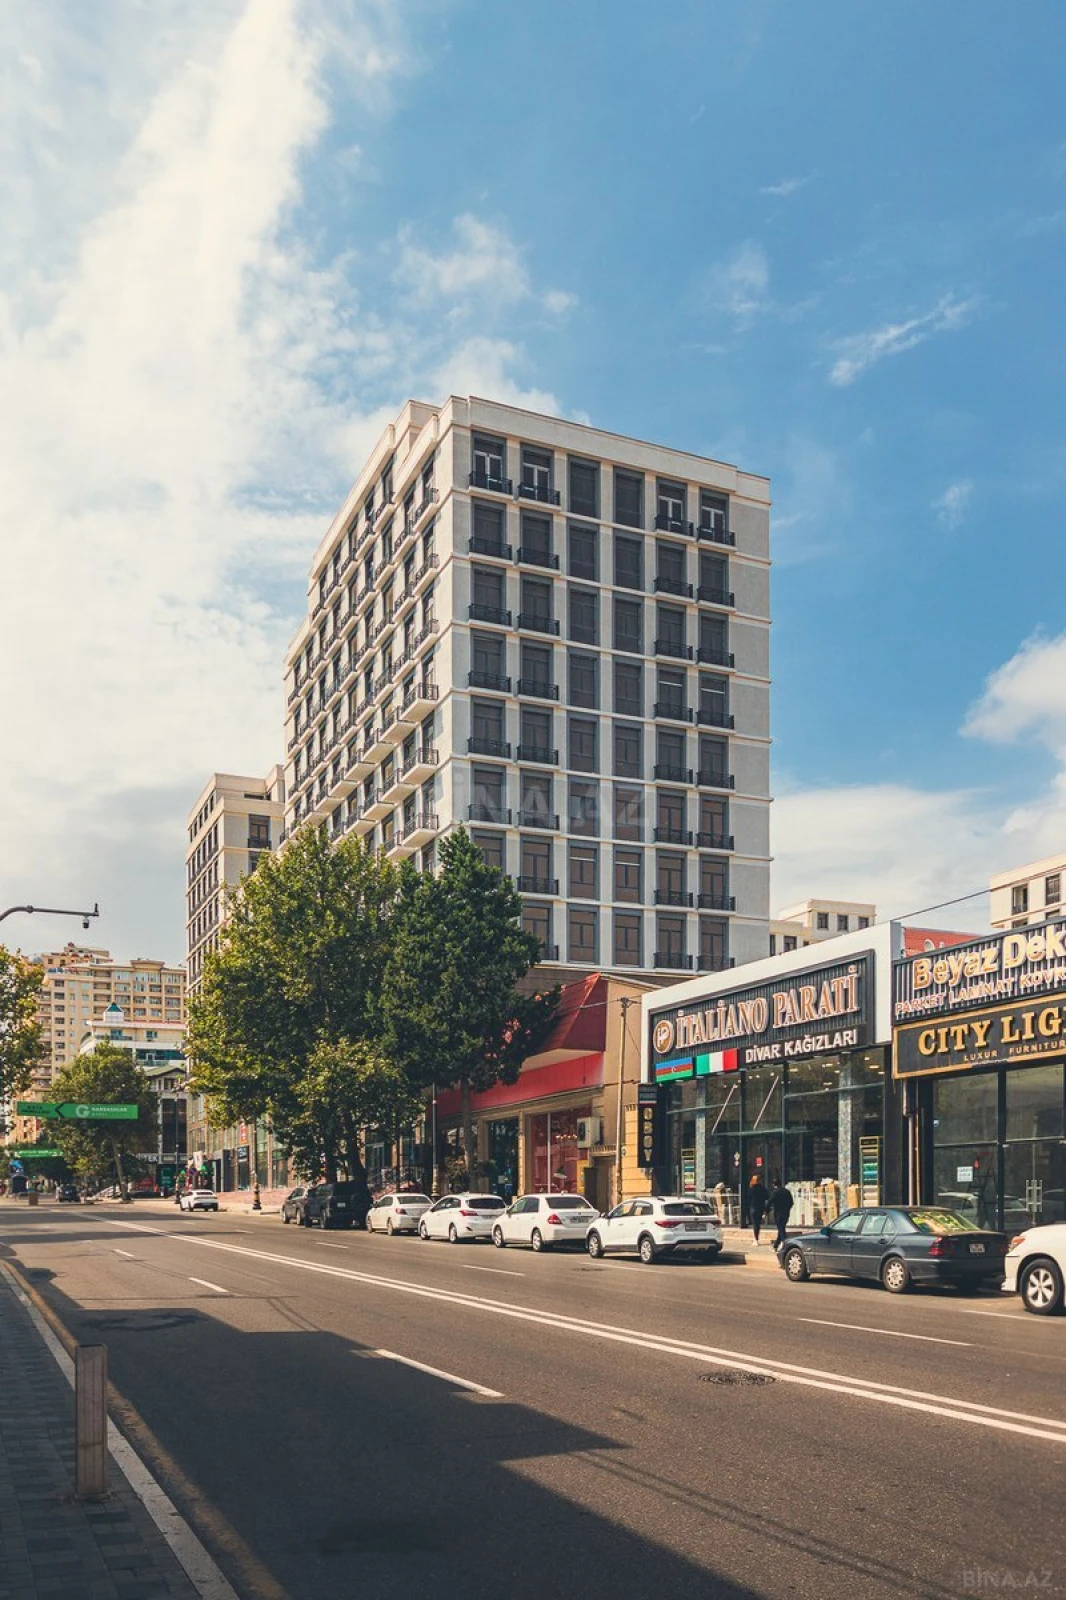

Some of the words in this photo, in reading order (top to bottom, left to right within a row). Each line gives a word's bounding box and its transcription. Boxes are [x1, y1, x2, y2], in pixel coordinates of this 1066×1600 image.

[912, 946, 999, 990] Beyaz
[1002, 924, 1066, 968] Dek
[772, 965, 860, 1029] PARATİ
[894, 991, 947, 1014] PARKET
[745, 1043, 782, 1064] DİVAR
[784, 1028, 858, 1057] KAĞIZLARI
[918, 1019, 991, 1056] CITY
[1000, 1006, 1066, 1044] LIG
[963, 1049, 998, 1062] LUXUR
